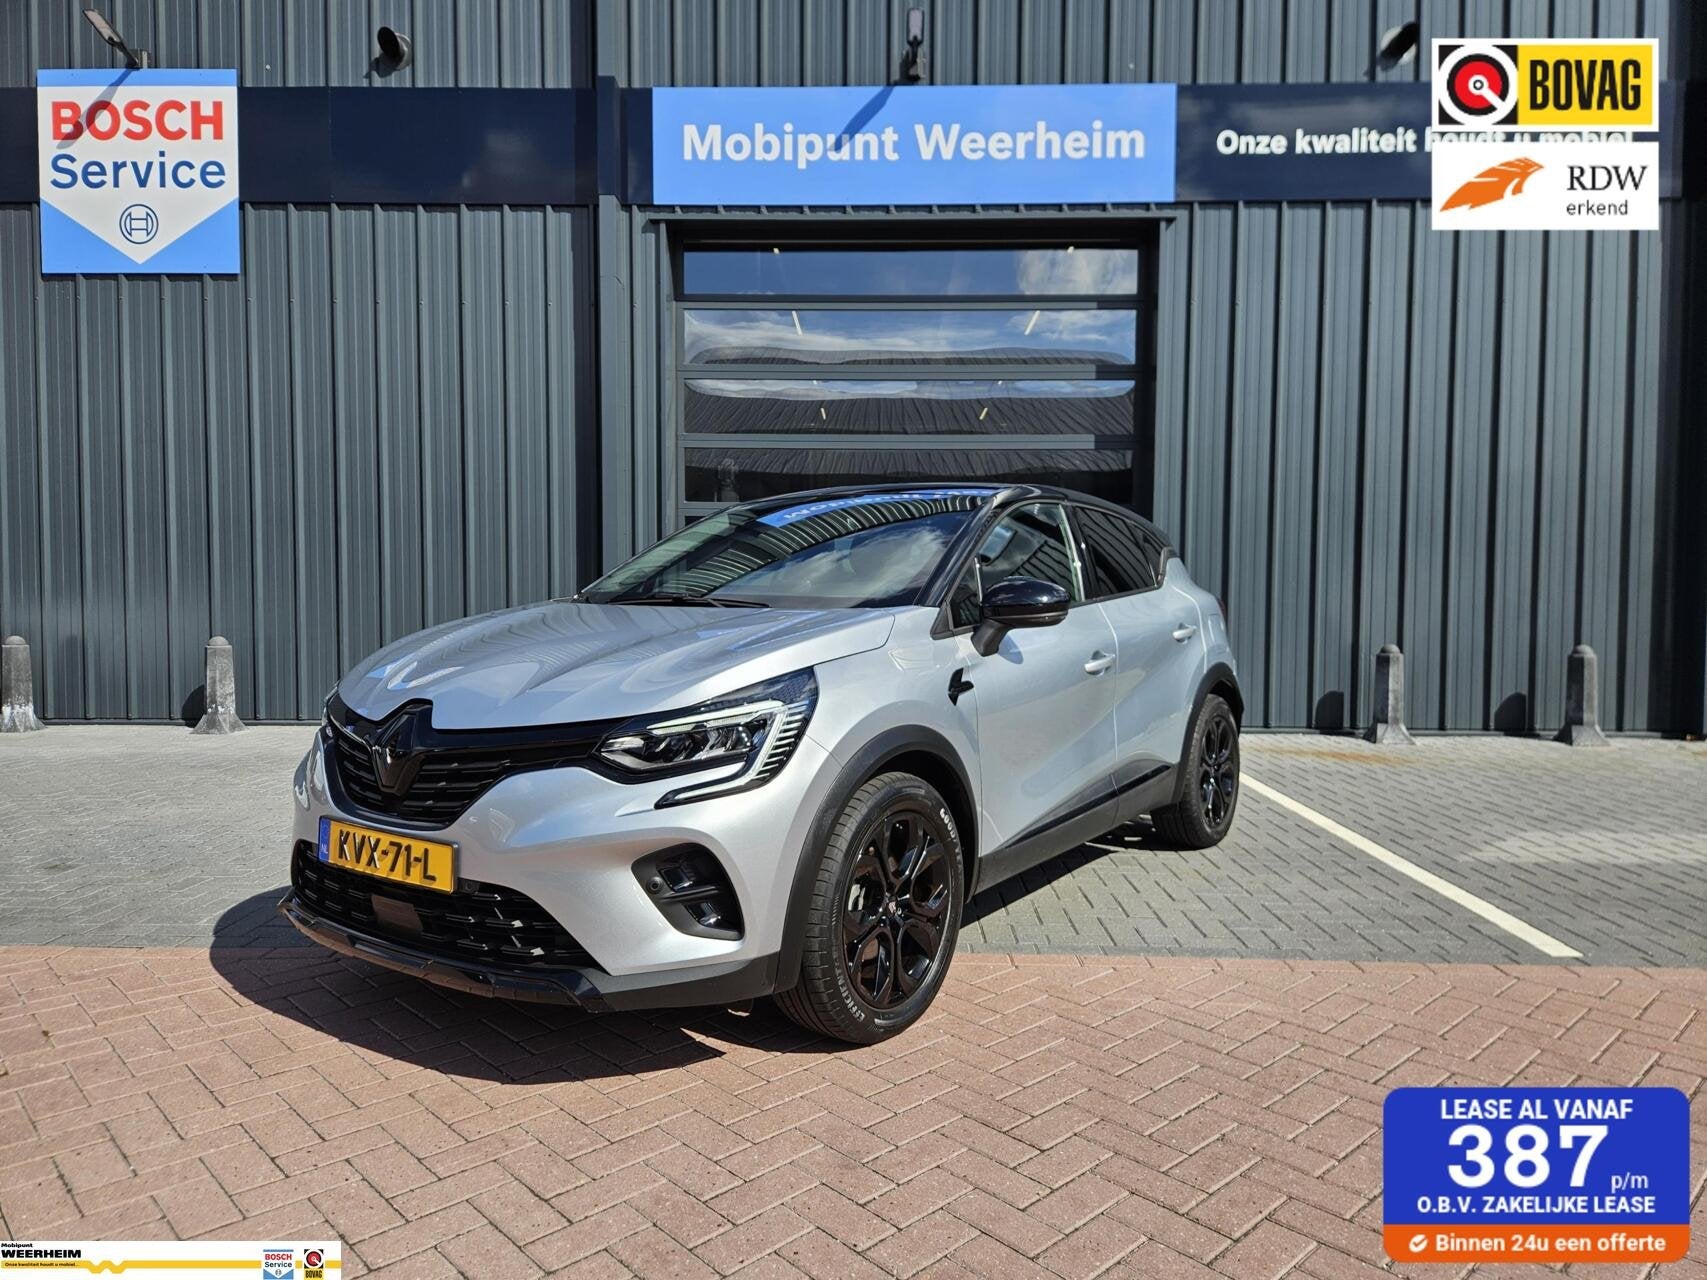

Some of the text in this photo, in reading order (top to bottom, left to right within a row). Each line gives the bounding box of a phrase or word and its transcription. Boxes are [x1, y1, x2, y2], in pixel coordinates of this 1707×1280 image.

[51, 100, 223, 141] BOSCH
[1216, 128, 1287, 155] Onze
[1295, 126, 1416, 153] kwaliteit
[682, 120, 1145, 169] Mobipunt Weerheim
[50, 151, 226, 189] Service
[338, 829, 436, 882] KVX-71-L
